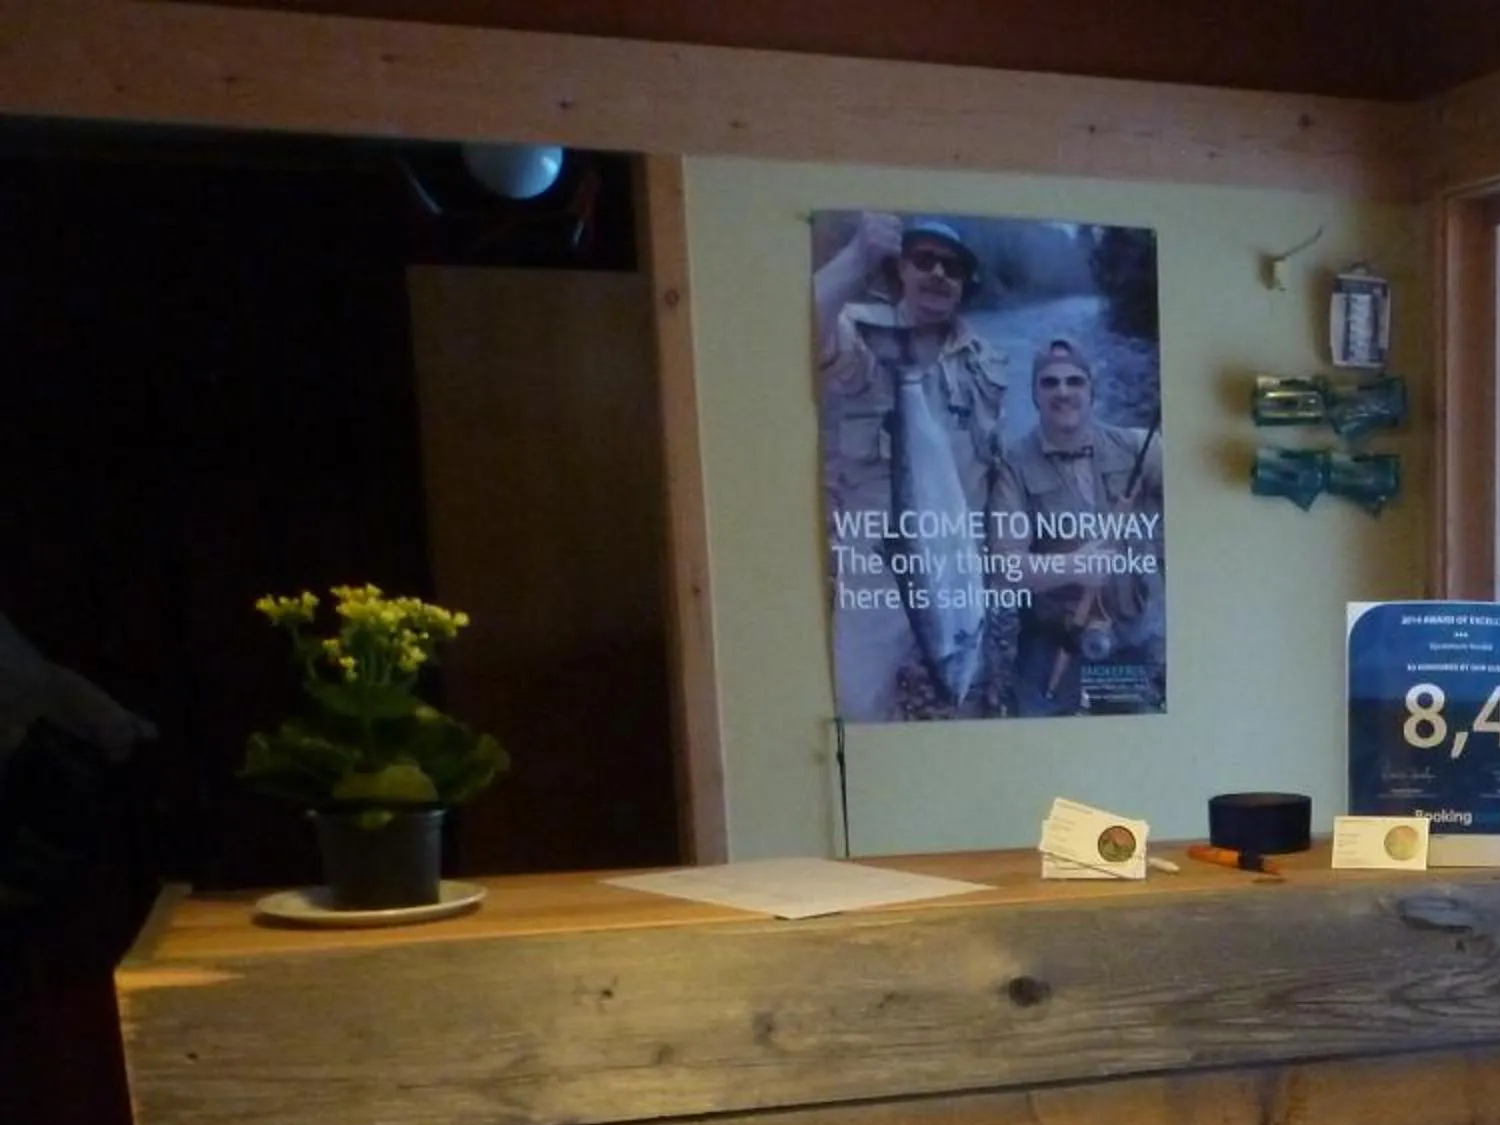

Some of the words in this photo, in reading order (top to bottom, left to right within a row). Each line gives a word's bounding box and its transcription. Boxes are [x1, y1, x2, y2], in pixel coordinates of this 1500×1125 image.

[832, 510, 986, 540] WELCOME
[990, 510, 1030, 540] TO
[1036, 510, 1160, 540] NORWAY
[831, 545, 884, 575] The
[890, 546, 947, 583] only
[956, 546, 1024, 583] thing
[1028, 553, 1066, 575] we
[1072, 546, 1159, 575] smoke
[838, 581, 901, 610] here
[907, 581, 931, 610] is
[936, 581, 1033, 610] salmon
